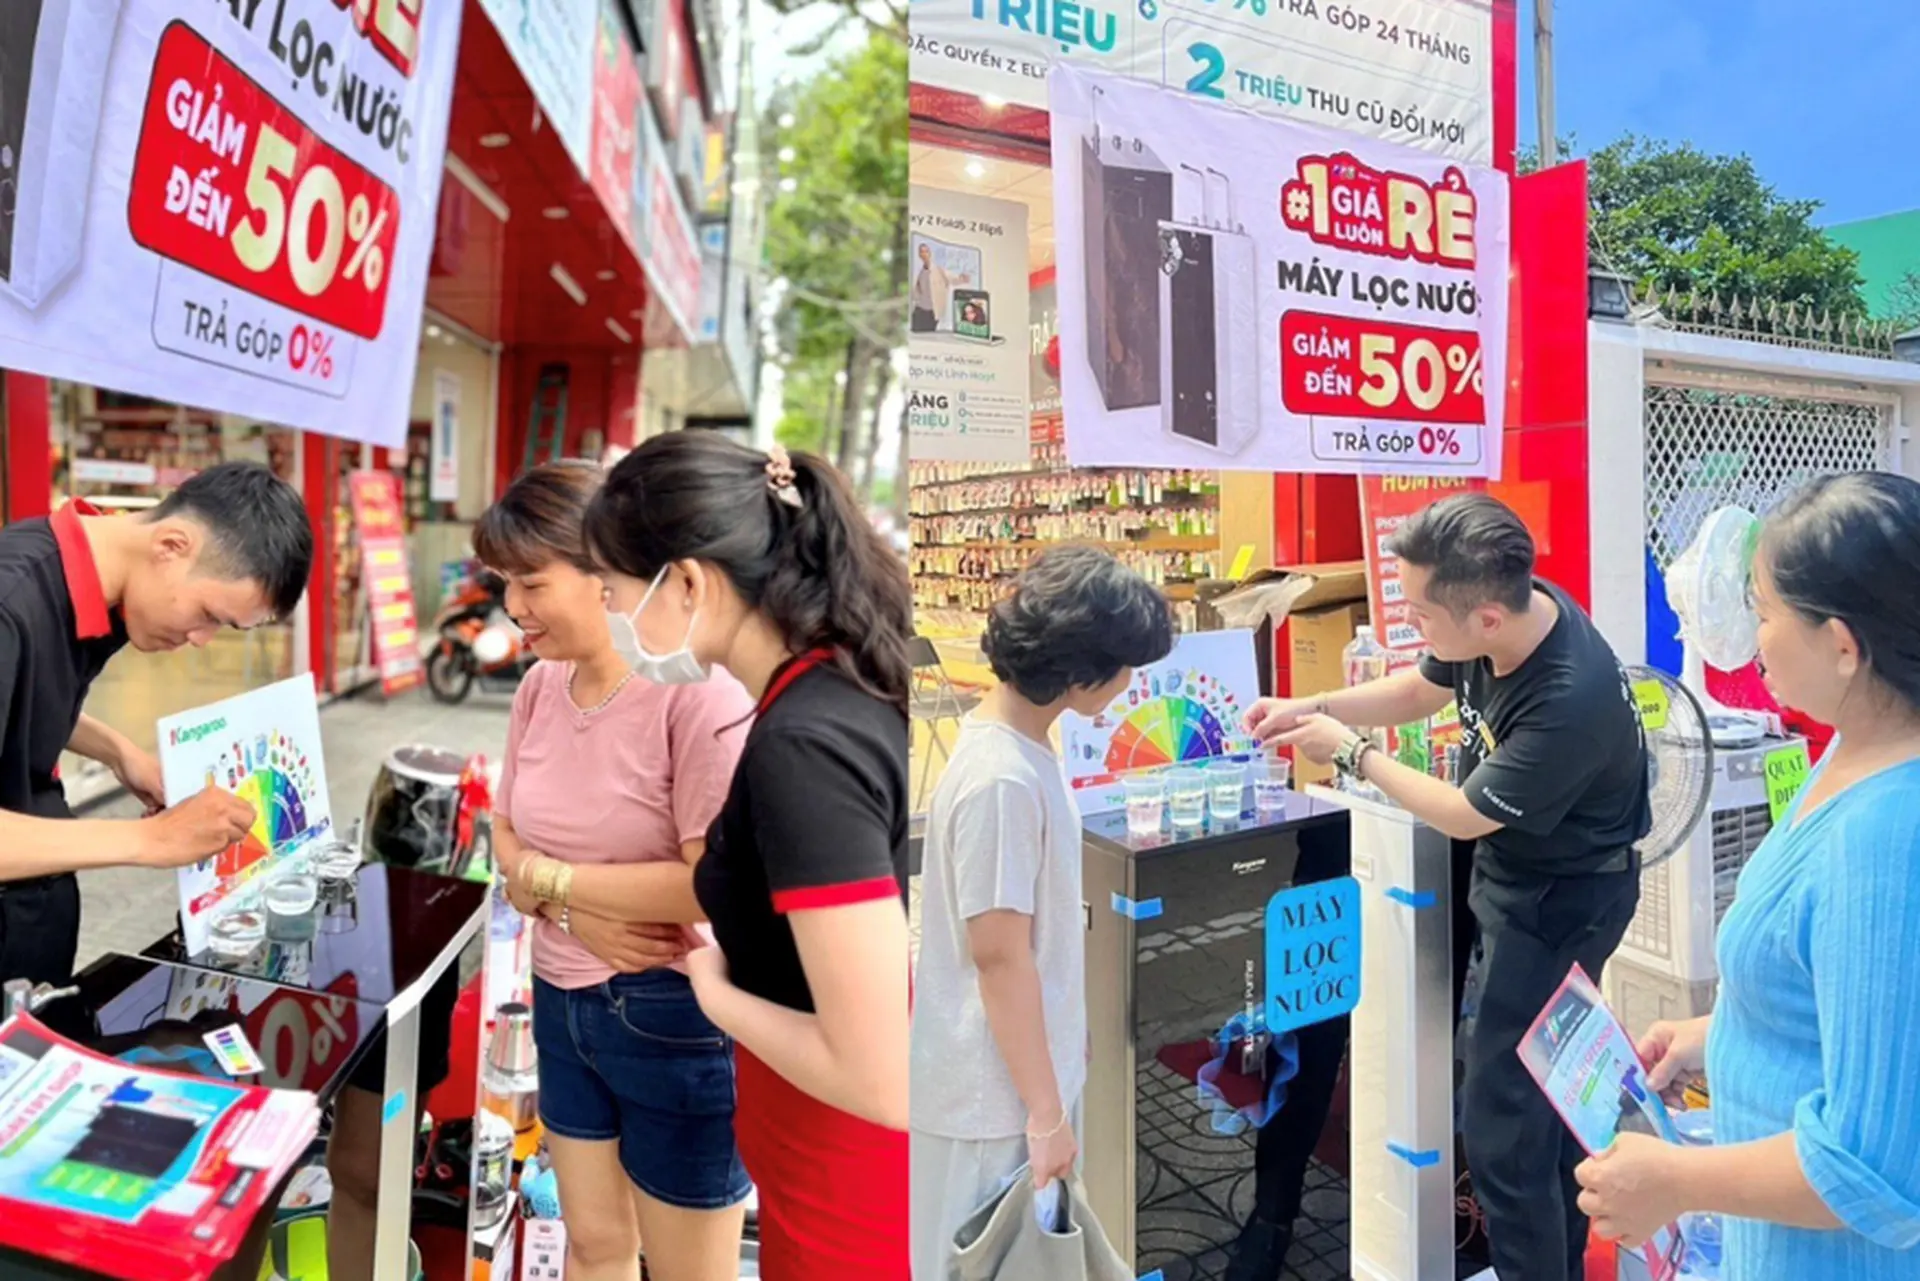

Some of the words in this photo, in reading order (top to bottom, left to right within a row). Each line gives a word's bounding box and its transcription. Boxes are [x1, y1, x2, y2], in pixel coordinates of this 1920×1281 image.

[1326, 5, 1371, 33] GÓP
[1376, 20, 1400, 45] 24
[1404, 29, 1471, 65] THÁNG
[1006, 59, 1017, 73] Z
[1186, 42, 1225, 99] 2
[1235, 69, 1302, 106] TRIỆU
[1307, 87, 1349, 116] THU
[1356, 100, 1385, 124] CŨ
[1389, 104, 1425, 136] ĐỔI
[1430, 118, 1465, 145] MỚI
[165, 78, 248, 167] GIẢM
[164, 165, 234, 238] ĐẾN
[230, 122, 388, 297] 50%
[1285, 163, 1330, 235] #1
[1332, 186, 1384, 222] GIÁ
[1387, 173, 1475, 261] RẺ
[1334, 221, 1384, 247] LUÔN
[1278, 256, 1343, 296] MÁY
[1351, 271, 1409, 310] LỌC
[1416, 280, 1482, 317] NƯỚ
[184, 299, 229, 348] TRẢ
[235, 316, 283, 363] GÓP
[286, 323, 334, 380] 0%
[1292, 327, 1350, 359] GIẢM
[1304, 365, 1352, 396] ĐẾN
[1357, 333, 1484, 412] 50%
[1333, 426, 1371, 452] TRẢ
[1376, 432, 1414, 453] GÓP
[1418, 427, 1461, 456] 0%
[170, 716, 227, 746] Kangaroo
[1282, 890, 1347, 932] MÁY
[1284, 935, 1348, 976] LỌC
[1274, 973, 1353, 1019] NƯỚC
